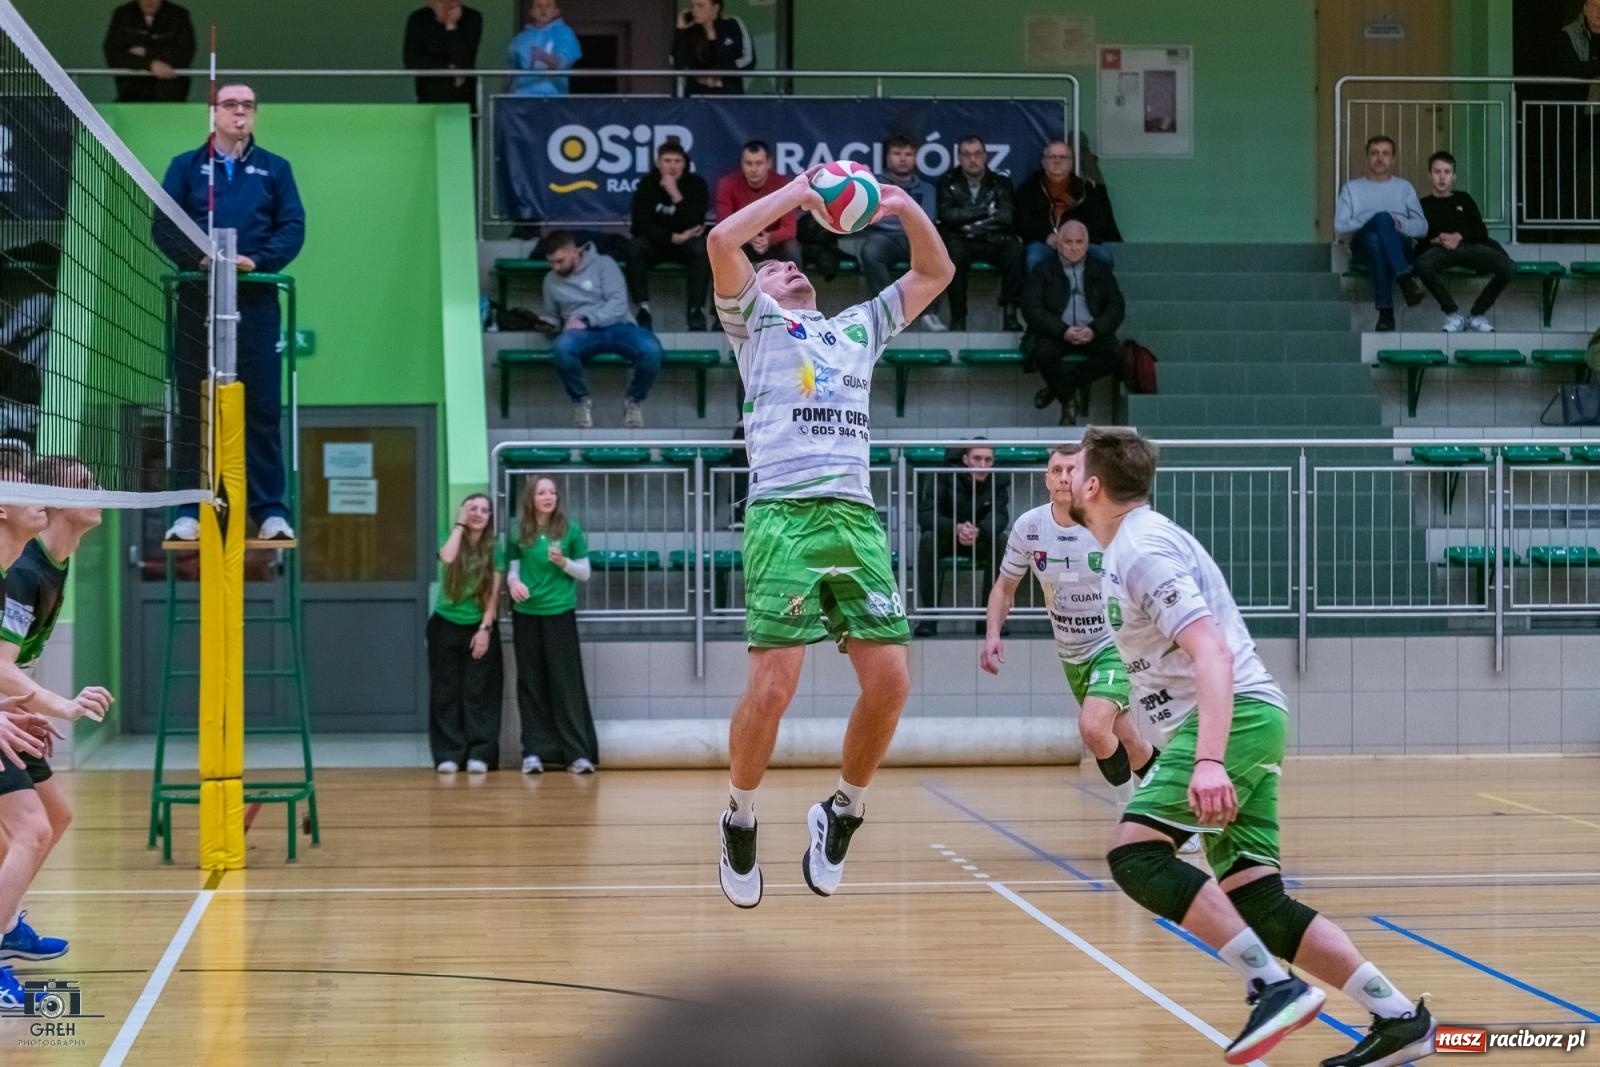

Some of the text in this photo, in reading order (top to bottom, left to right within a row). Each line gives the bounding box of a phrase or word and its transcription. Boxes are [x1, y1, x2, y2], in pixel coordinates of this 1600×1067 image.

[819, 331, 837, 346] 16
[792, 407, 842, 422] POMPY
[811, 425, 836, 435] 605
[838, 427, 857, 438] 944
[1064, 556, 1069, 569] 1
[1107, 669, 1115, 686] 1
